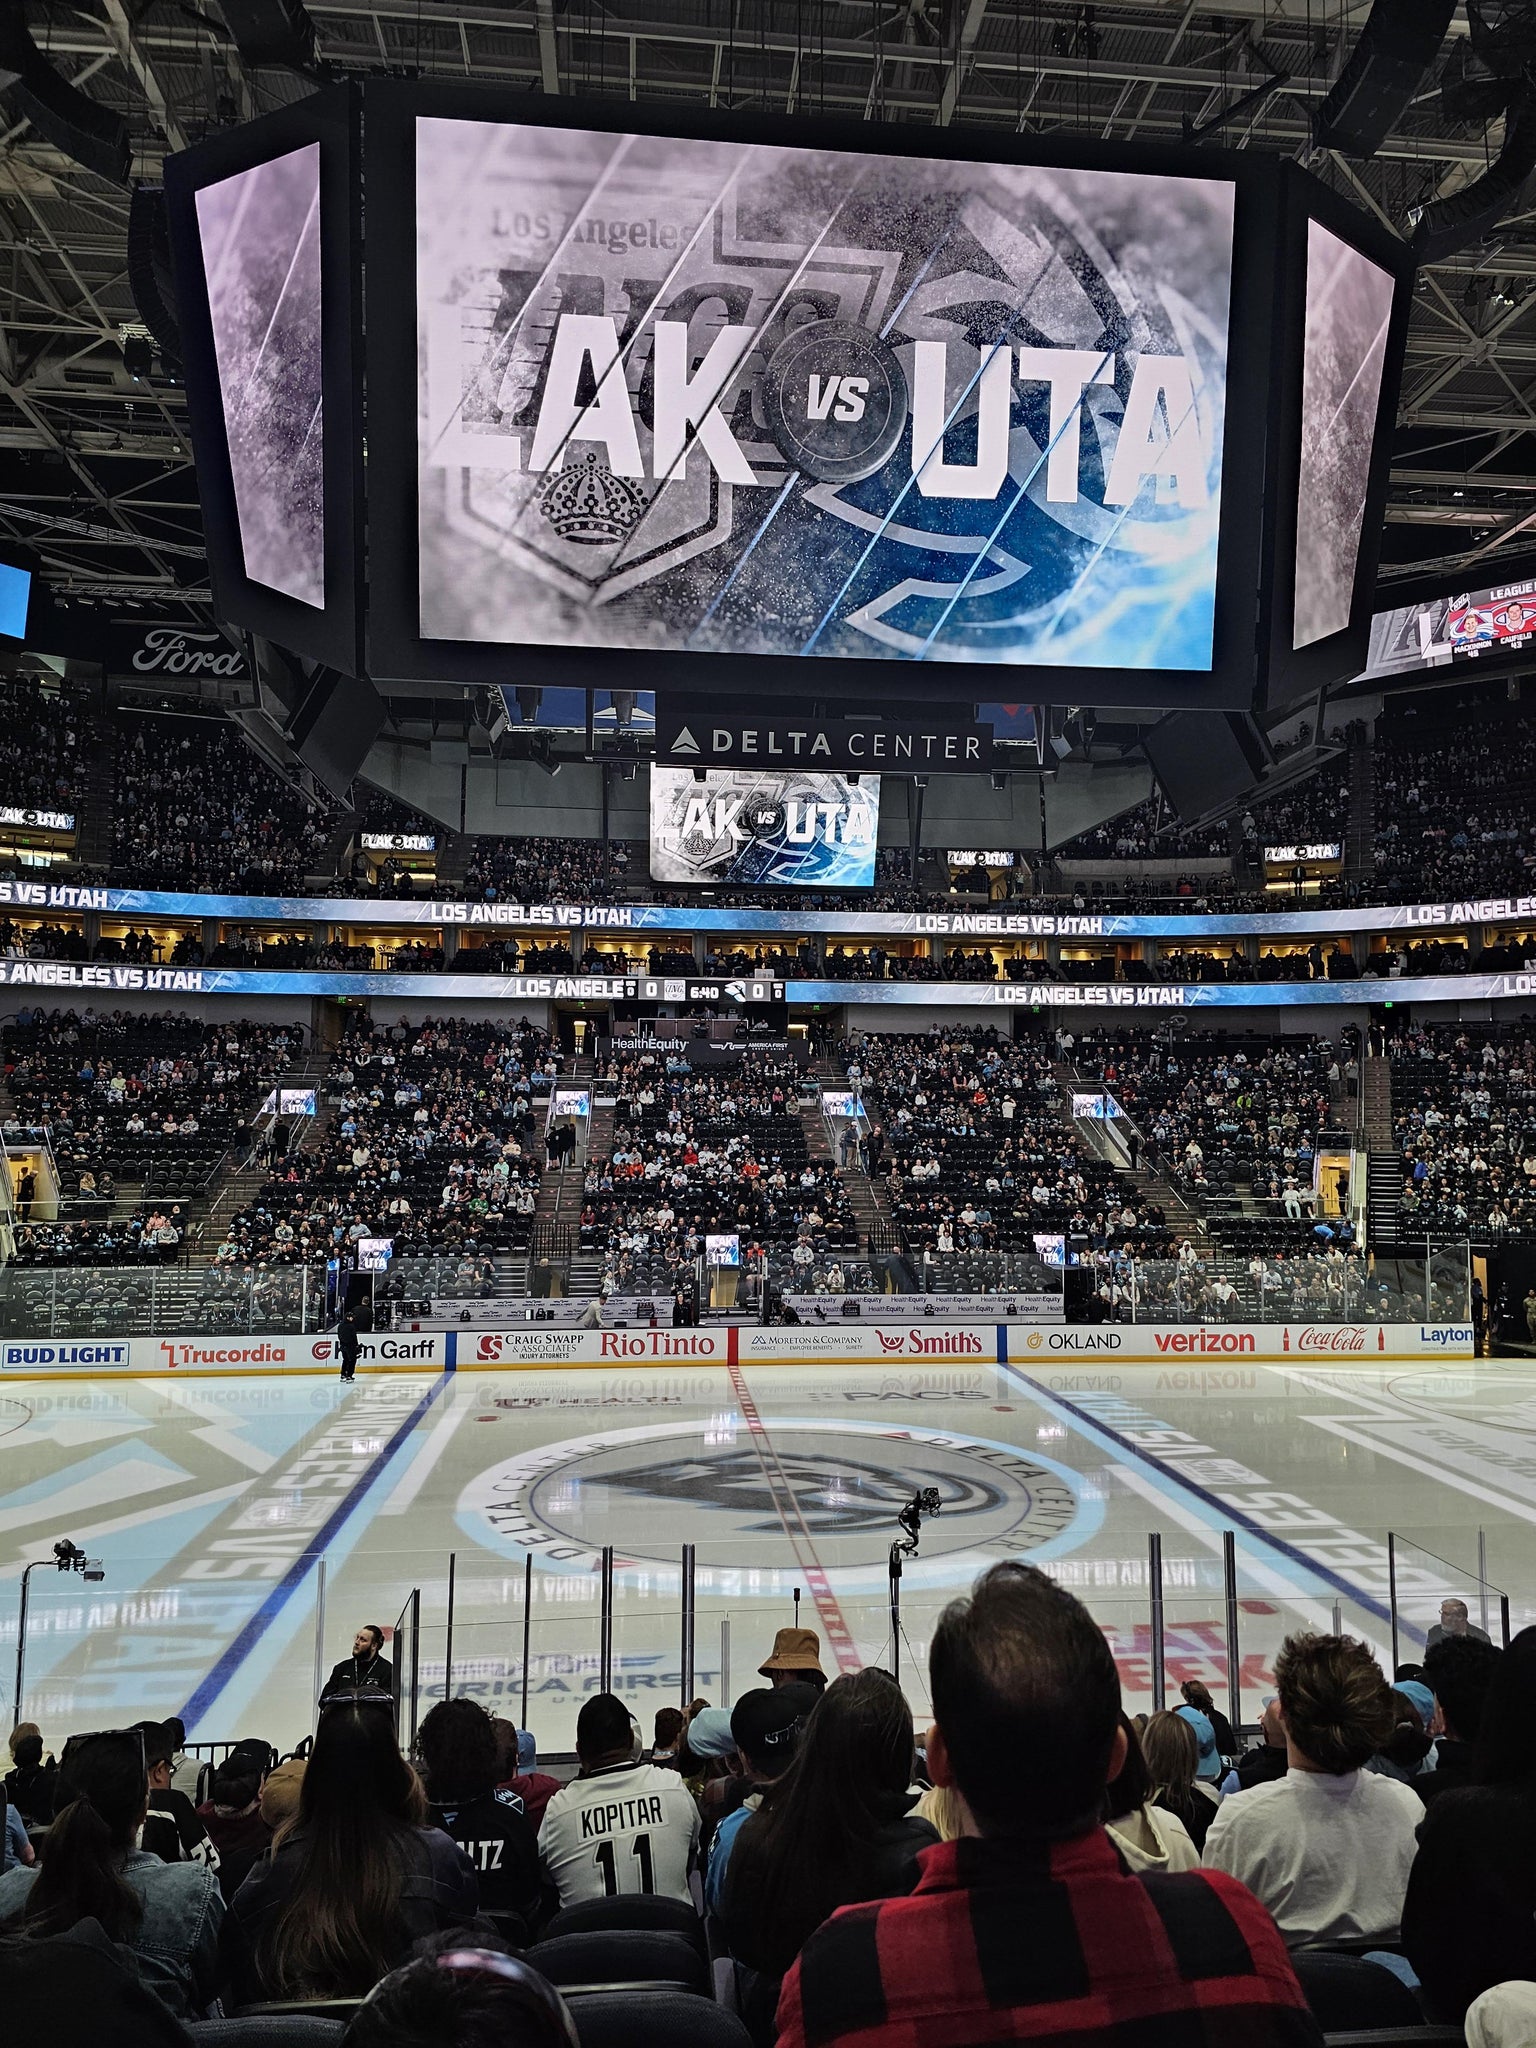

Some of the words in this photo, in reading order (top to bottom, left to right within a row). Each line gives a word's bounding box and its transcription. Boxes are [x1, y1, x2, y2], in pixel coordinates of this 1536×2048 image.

[807, 374, 869, 422] VS
[912, 340, 1203, 507] UTA
[1490, 582, 1533, 600] LEAGUE
[132, 629, 244, 675] Ford
[712, 729, 831, 755] DELTA
[848, 733, 980, 759] CENTER
[37, 812, 66, 828] UTA
[654, 798, 744, 841] LAK
[757, 811, 776, 823] VS
[787, 802, 873, 843] UTA
[403, 835, 429, 850] UTA
[16, 884, 46, 904] VS
[50, 886, 108, 908] UTAH
[431, 904, 467, 921] LOS
[471, 904, 553, 923] ANGELES
[557, 906, 582, 923] VS
[584, 907, 632, 926] UTAH
[1406, 905, 1446, 924] LOS
[916, 915, 949, 932] LOS
[951, 915, 1029, 933] ANGELES
[1031, 916, 1055, 933] VS
[1057, 917, 1102, 934] UTAH
[11, 964, 110, 986] ANGELES
[114, 968, 145, 987] VS
[147, 969, 201, 989] UTAH
[515, 980, 550, 997] LOS
[645, 982, 658, 997] 0
[690, 986, 719, 999] 6:40
[752, 984, 764, 998] 0
[994, 987, 1026, 1003] LOS
[1030, 987, 1104, 1004] ANGELES
[1107, 988, 1133, 1004] VS
[1136, 988, 1184, 1004] UTAH
[611, 1038, 687, 1050] HealthEquity
[505, 1334, 543, 1346] CRAIG
[545, 1334, 584, 1345] SWAPP
[909, 1329, 982, 1354] Smith's
[1049, 1333, 1121, 1349] OKLAND
[1154, 1328, 1255, 1352] verizon
[1421, 1327, 1473, 1345] Layton
[7, 1348, 56, 1364] BUD
[59, 1346, 125, 1363] LIGHT
[179, 1343, 286, 1364] Trucordia
[380, 1339, 435, 1359] Garff
[519, 1352, 543, 1360] INJURY
[521, 1344, 577, 1353] ASSOCIATES
[842, 1391, 991, 1401] PACS
[580, 1796, 663, 1839] KOPITAR
[594, 1833, 655, 1896] 11
